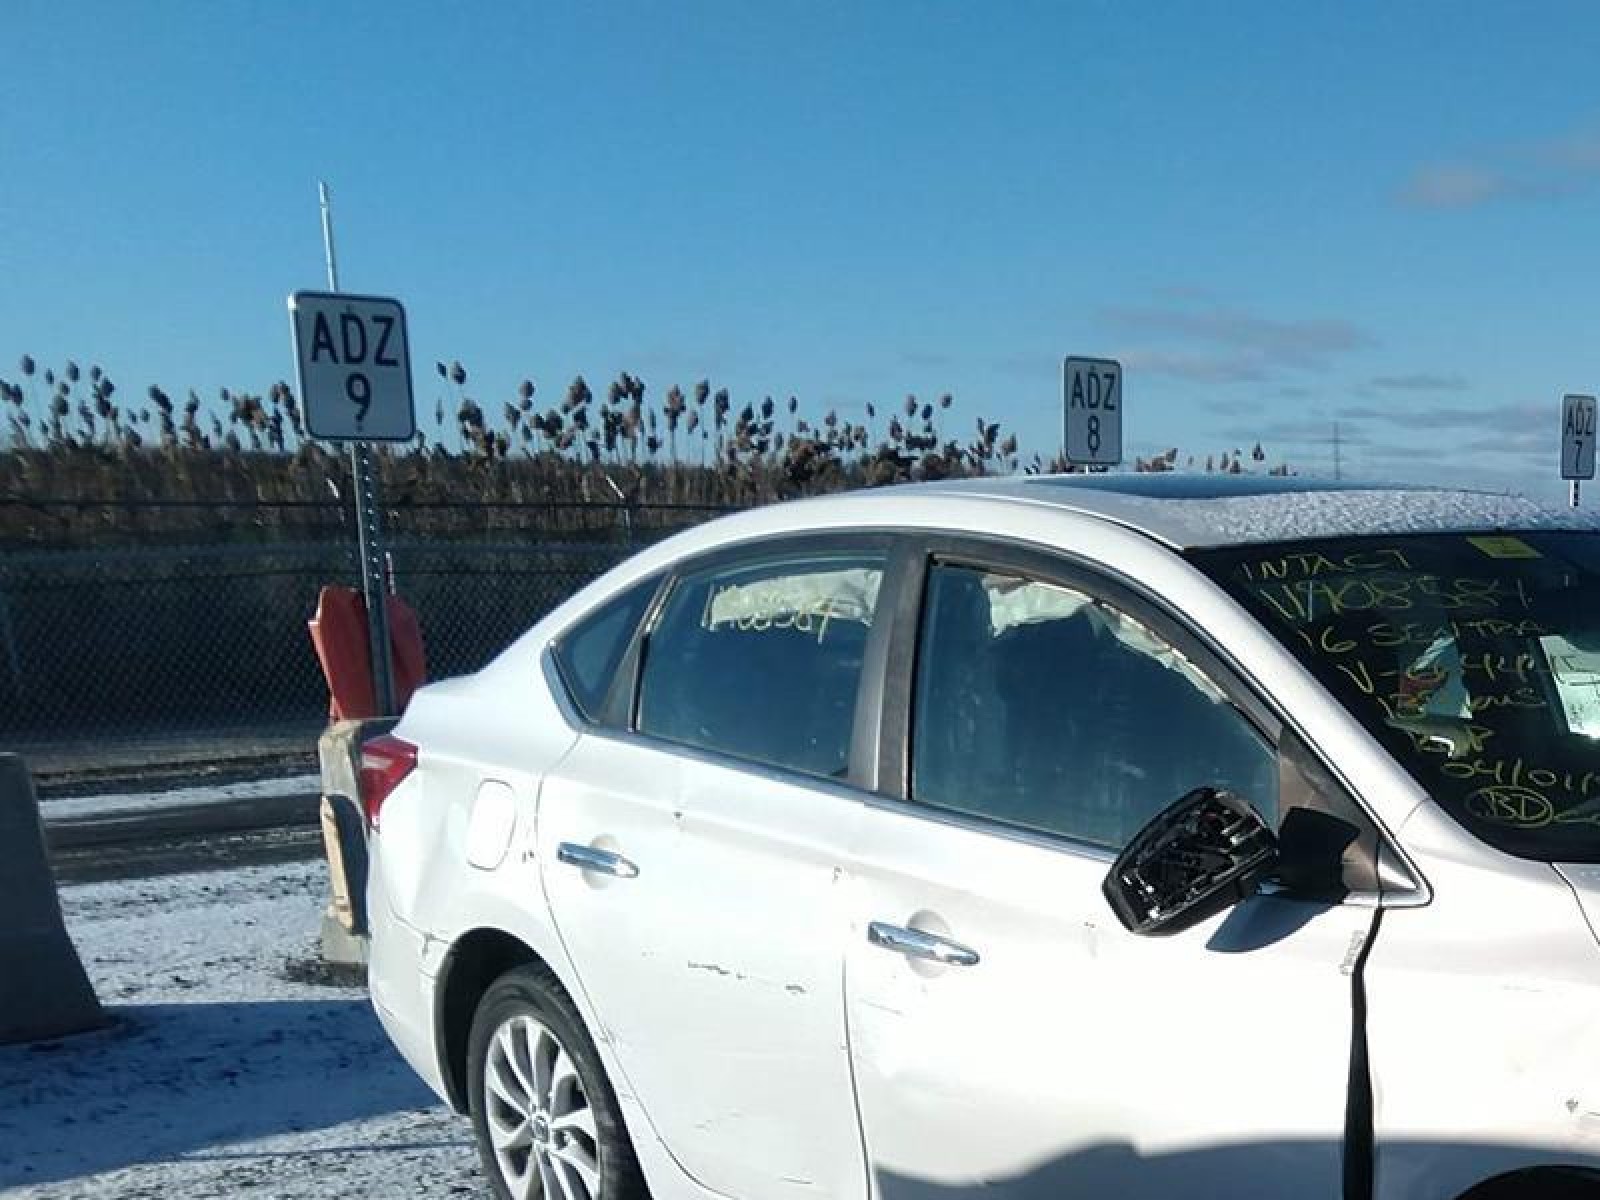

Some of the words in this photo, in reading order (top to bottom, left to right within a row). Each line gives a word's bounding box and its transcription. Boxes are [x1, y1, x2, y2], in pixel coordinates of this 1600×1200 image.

[310, 312, 399, 367] ADZ
[346, 373, 371, 423] 9
[1071, 371, 1117, 411] ADZ
[1087, 415, 1100, 452] 8
[1242, 550, 1411, 580] INTACT
